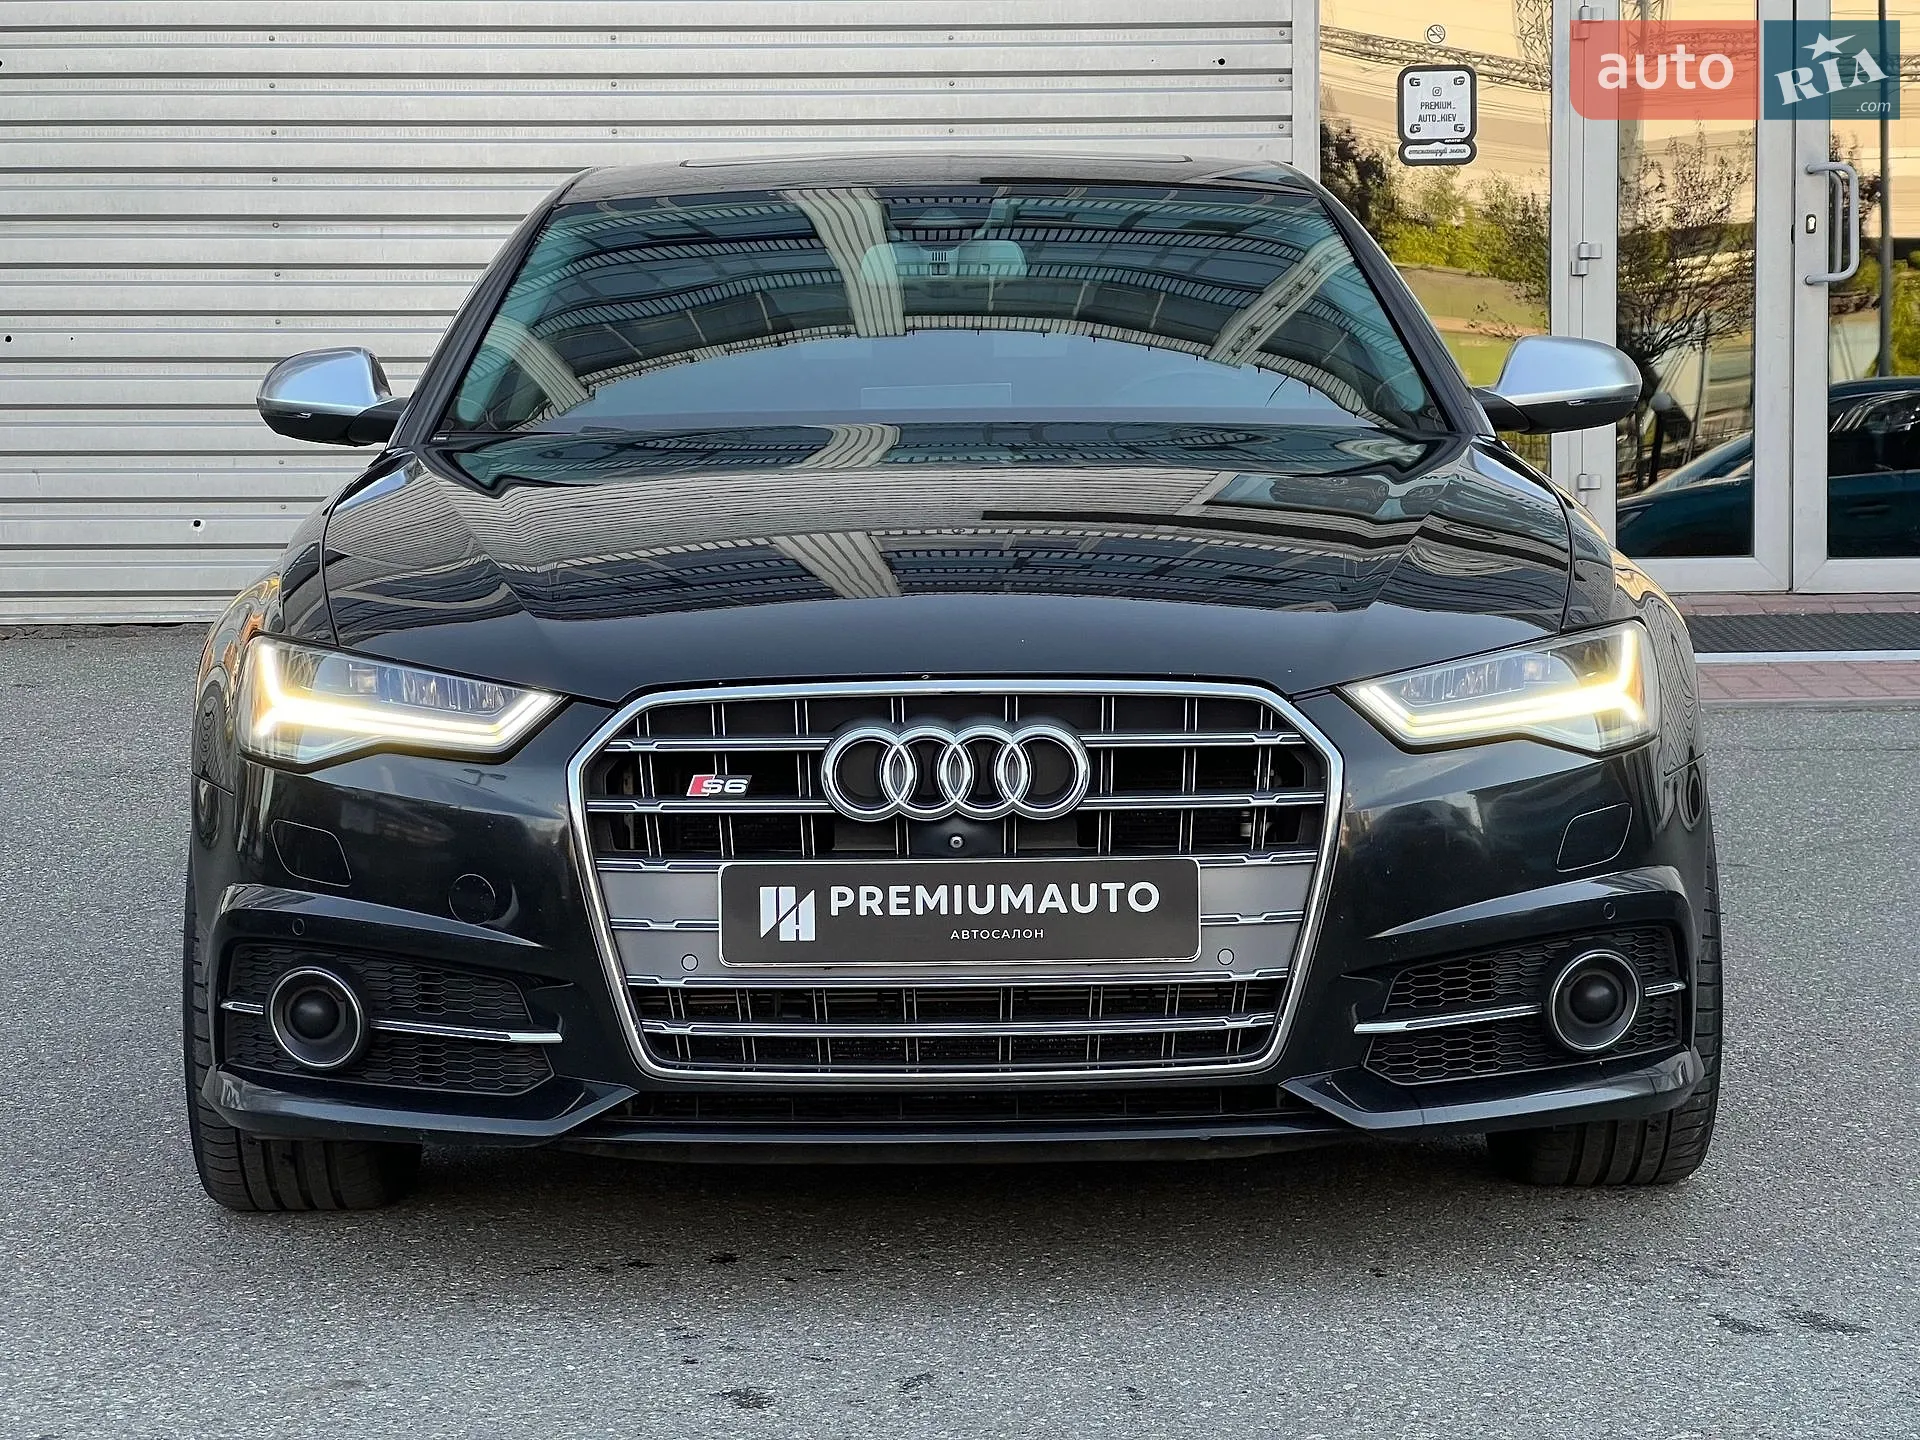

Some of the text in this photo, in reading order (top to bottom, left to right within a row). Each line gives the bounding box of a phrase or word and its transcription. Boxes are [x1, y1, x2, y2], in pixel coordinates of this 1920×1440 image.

[701, 779, 748, 794] S6
[829, 881, 1160, 917] PREMIUMAUTO
[950, 928, 1045, 941] АВТОСАЛОН
